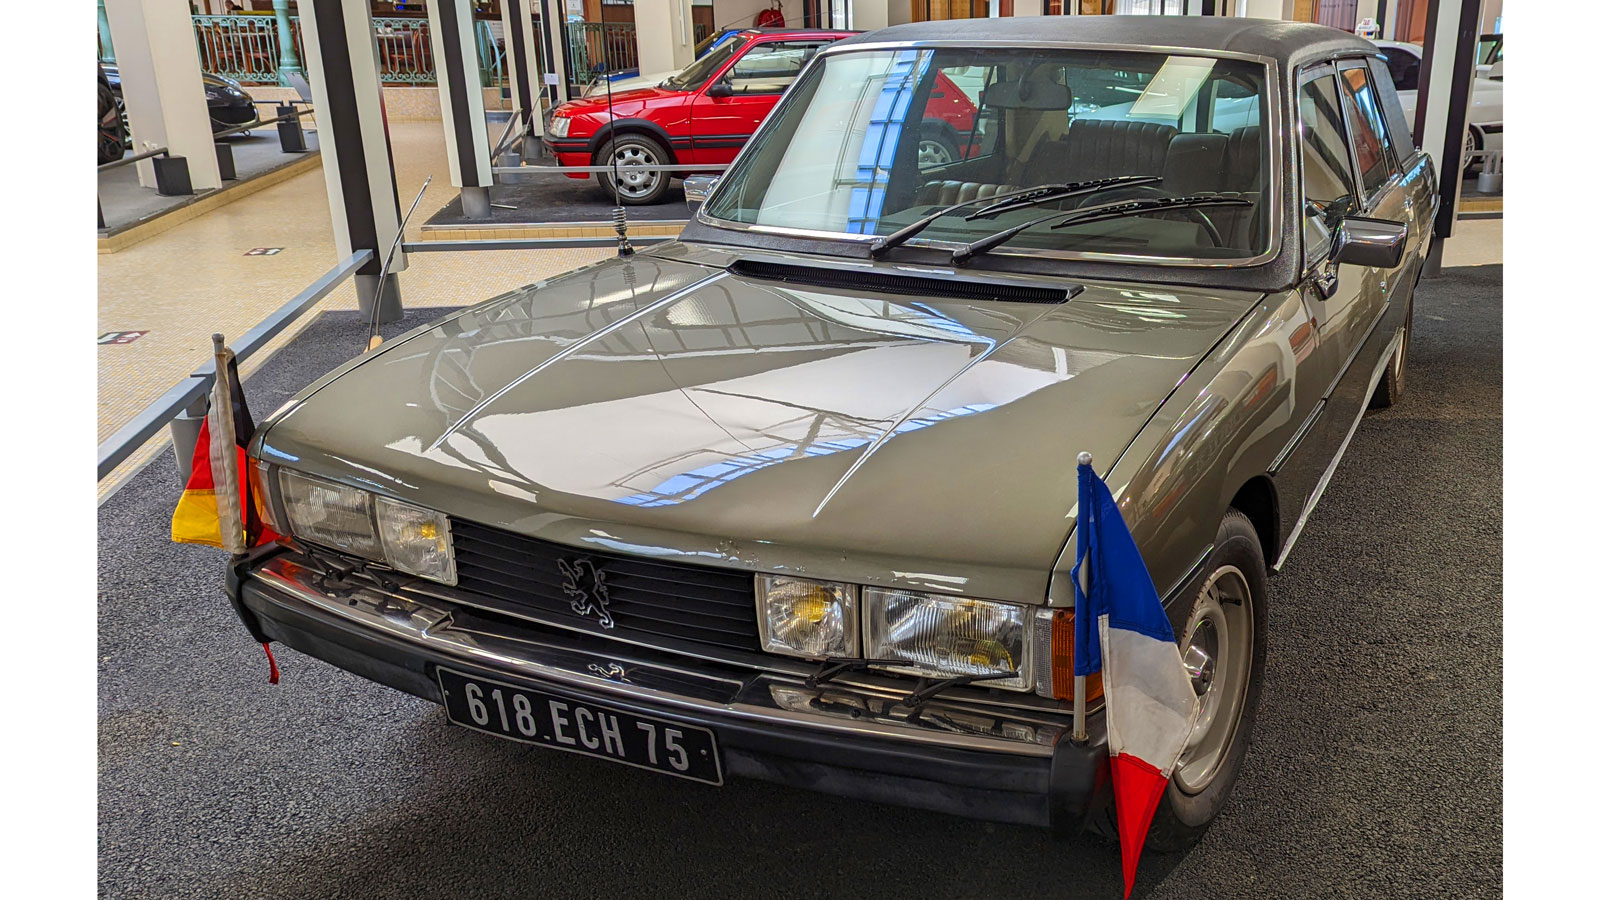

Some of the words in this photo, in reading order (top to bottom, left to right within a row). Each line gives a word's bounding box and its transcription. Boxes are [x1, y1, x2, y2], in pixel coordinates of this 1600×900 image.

[464, 682, 537, 738] 618
[550, 700, 626, 757] ECH
[636, 722, 690, 771] 75
